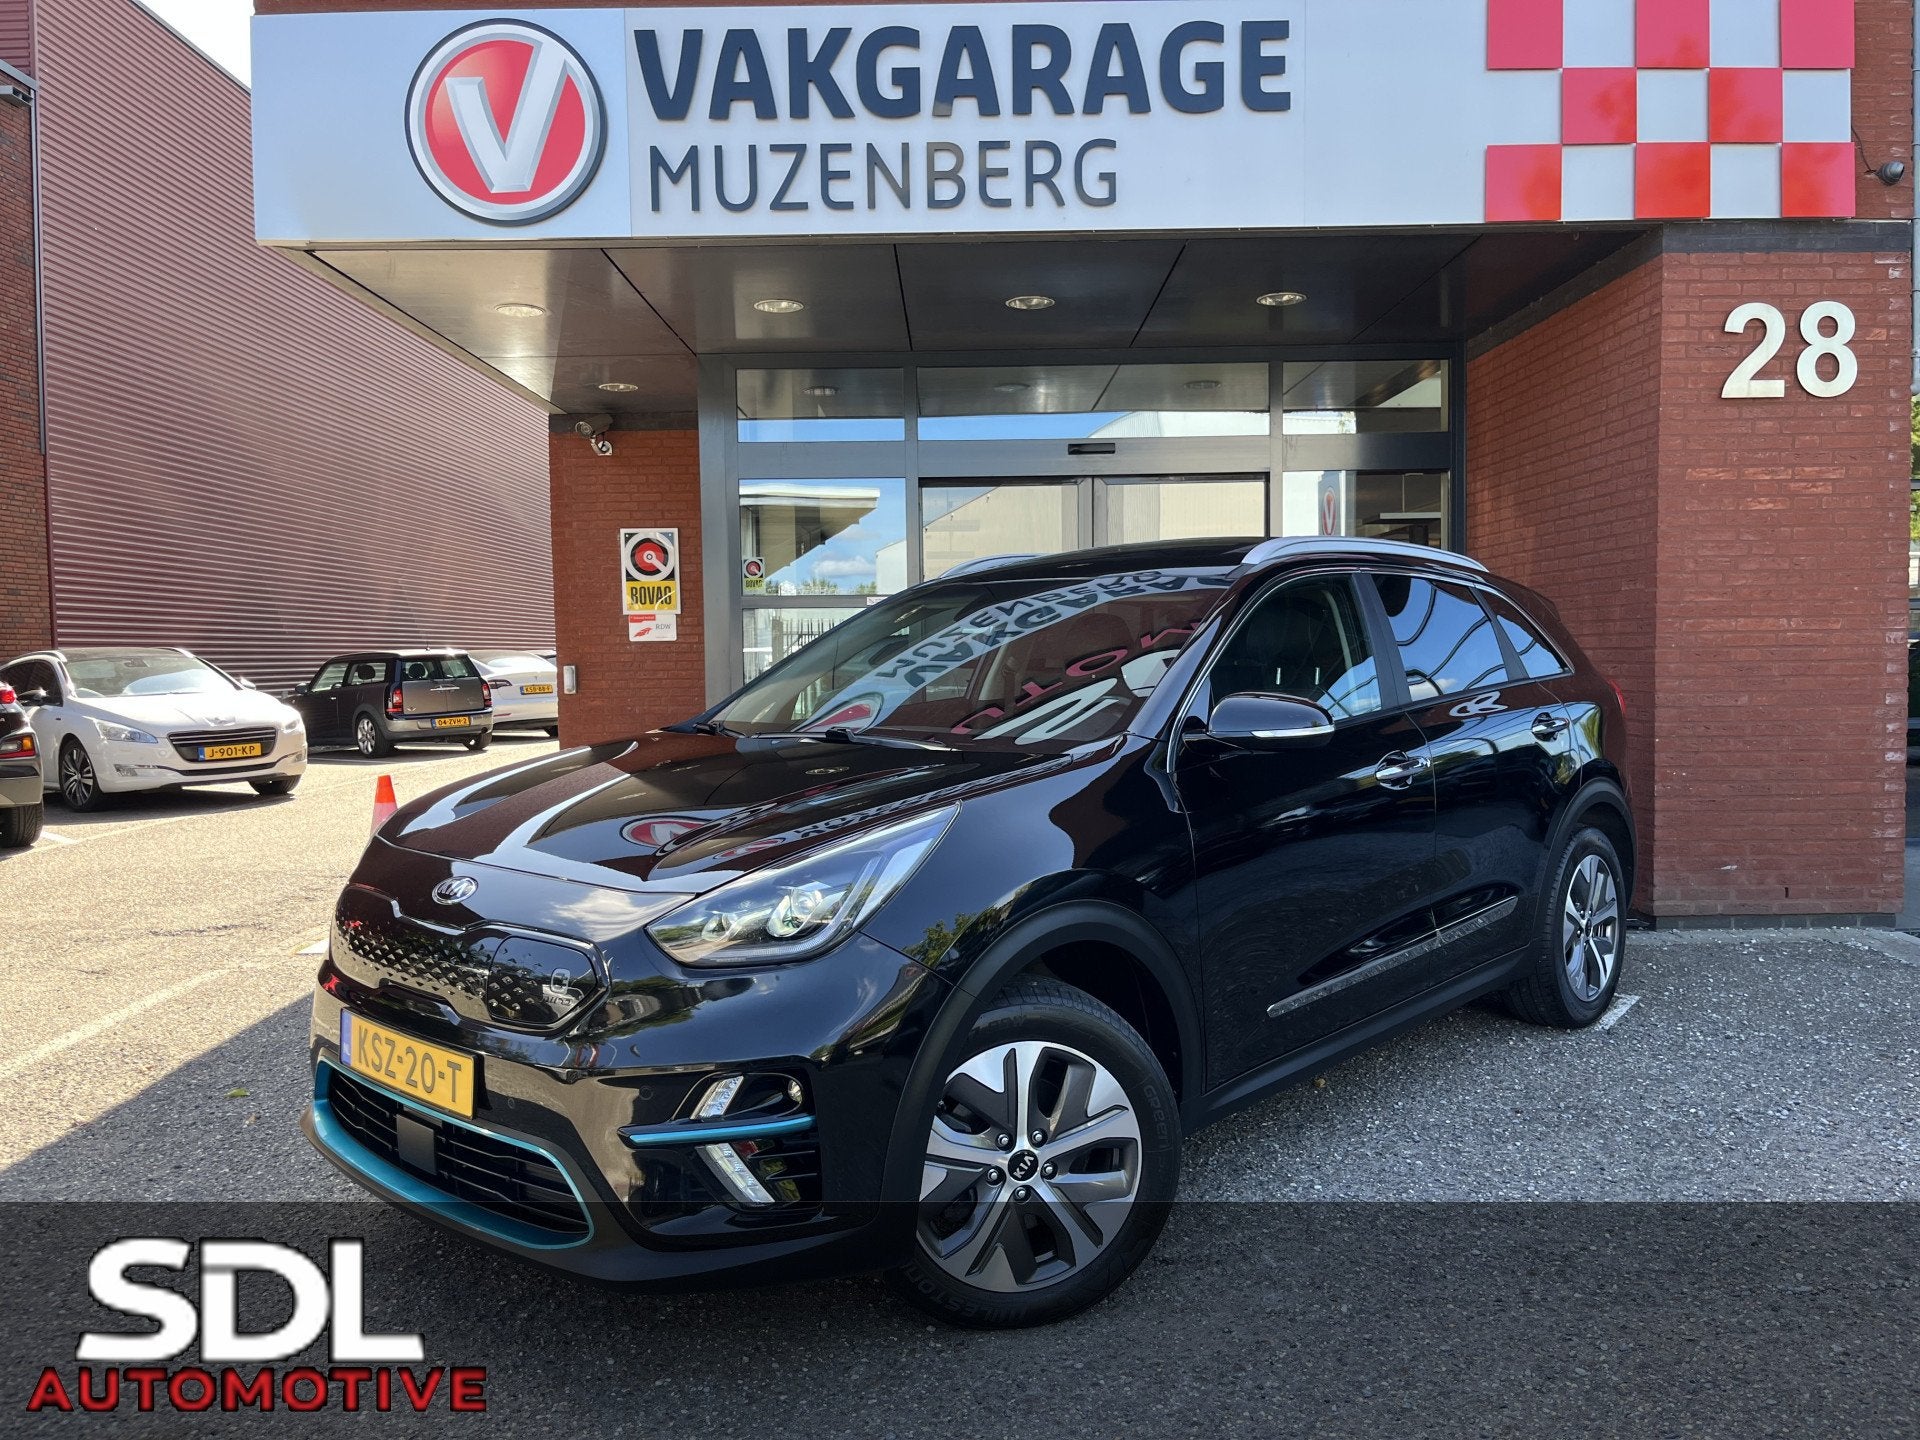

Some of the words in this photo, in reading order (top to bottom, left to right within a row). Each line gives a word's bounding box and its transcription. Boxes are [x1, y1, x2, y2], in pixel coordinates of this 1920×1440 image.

[633, 20, 1291, 120] VAKGARAGE
[650, 138, 1118, 212] MUZENBERG
[1721, 300, 1858, 399] 28
[630, 586, 672, 605] BOVAG
[209, 745, 255, 758] J-901-KP
[358, 1024, 463, 1103] KSZ-20-T
[1012, 1155, 1035, 1179] KIA
